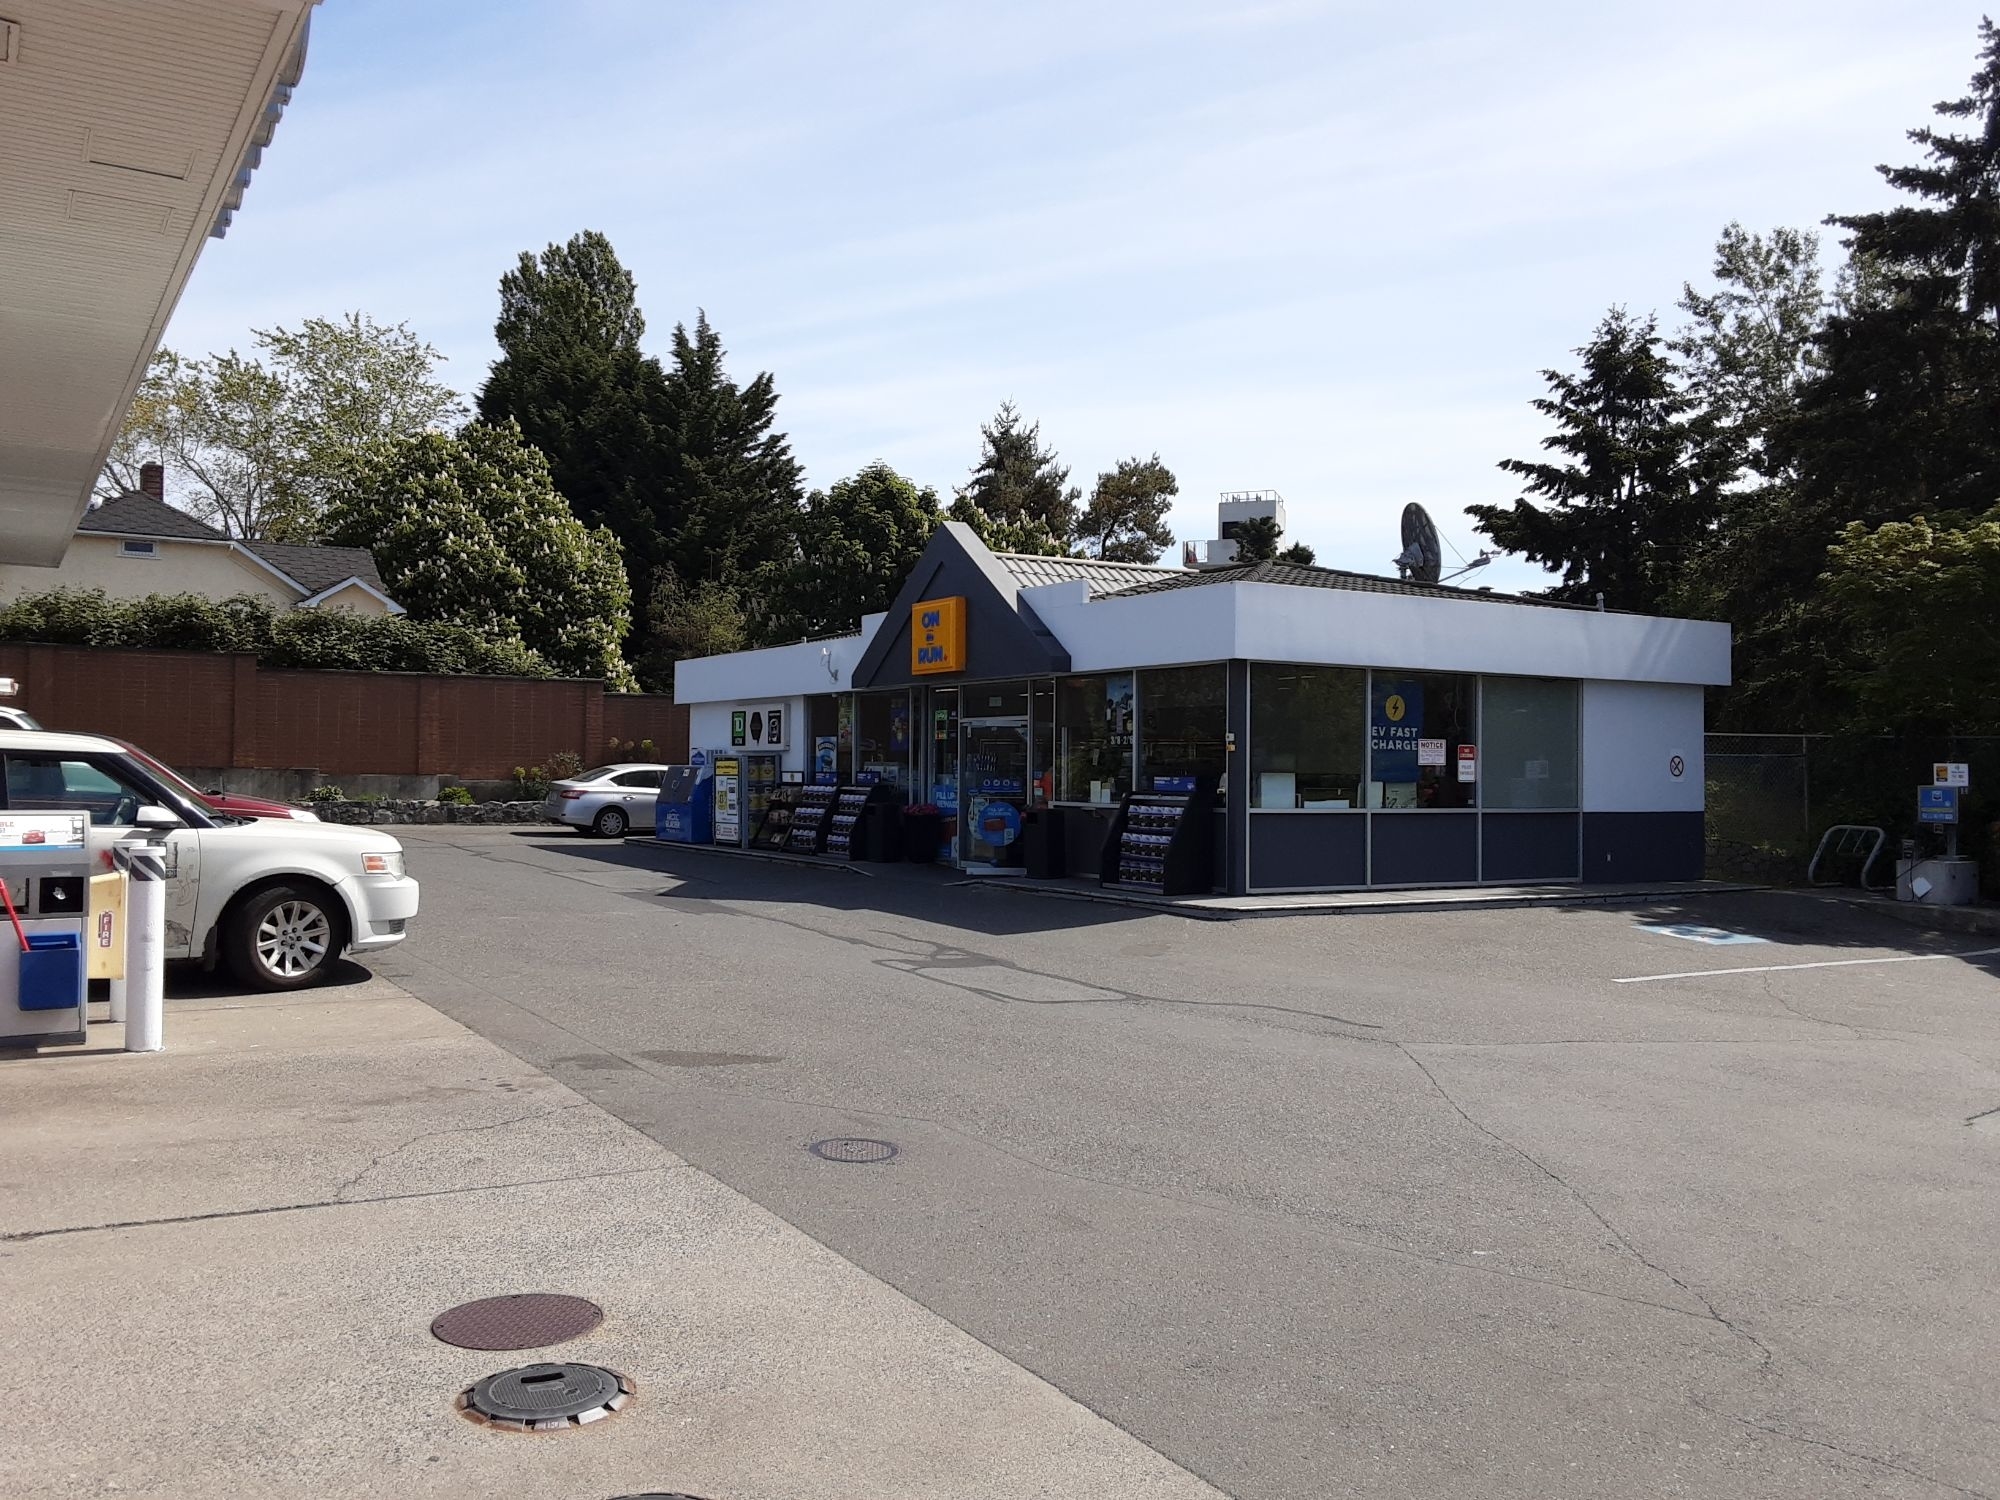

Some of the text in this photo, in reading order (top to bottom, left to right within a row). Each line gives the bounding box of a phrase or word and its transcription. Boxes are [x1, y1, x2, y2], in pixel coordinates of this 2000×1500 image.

[922, 610, 940, 629] ON
[918, 646, 943, 664] RUN
[1372, 727, 1418, 738] EV FAST
[1371, 739, 1418, 751] CHARGE
[103, 916, 111, 946] FIRE
